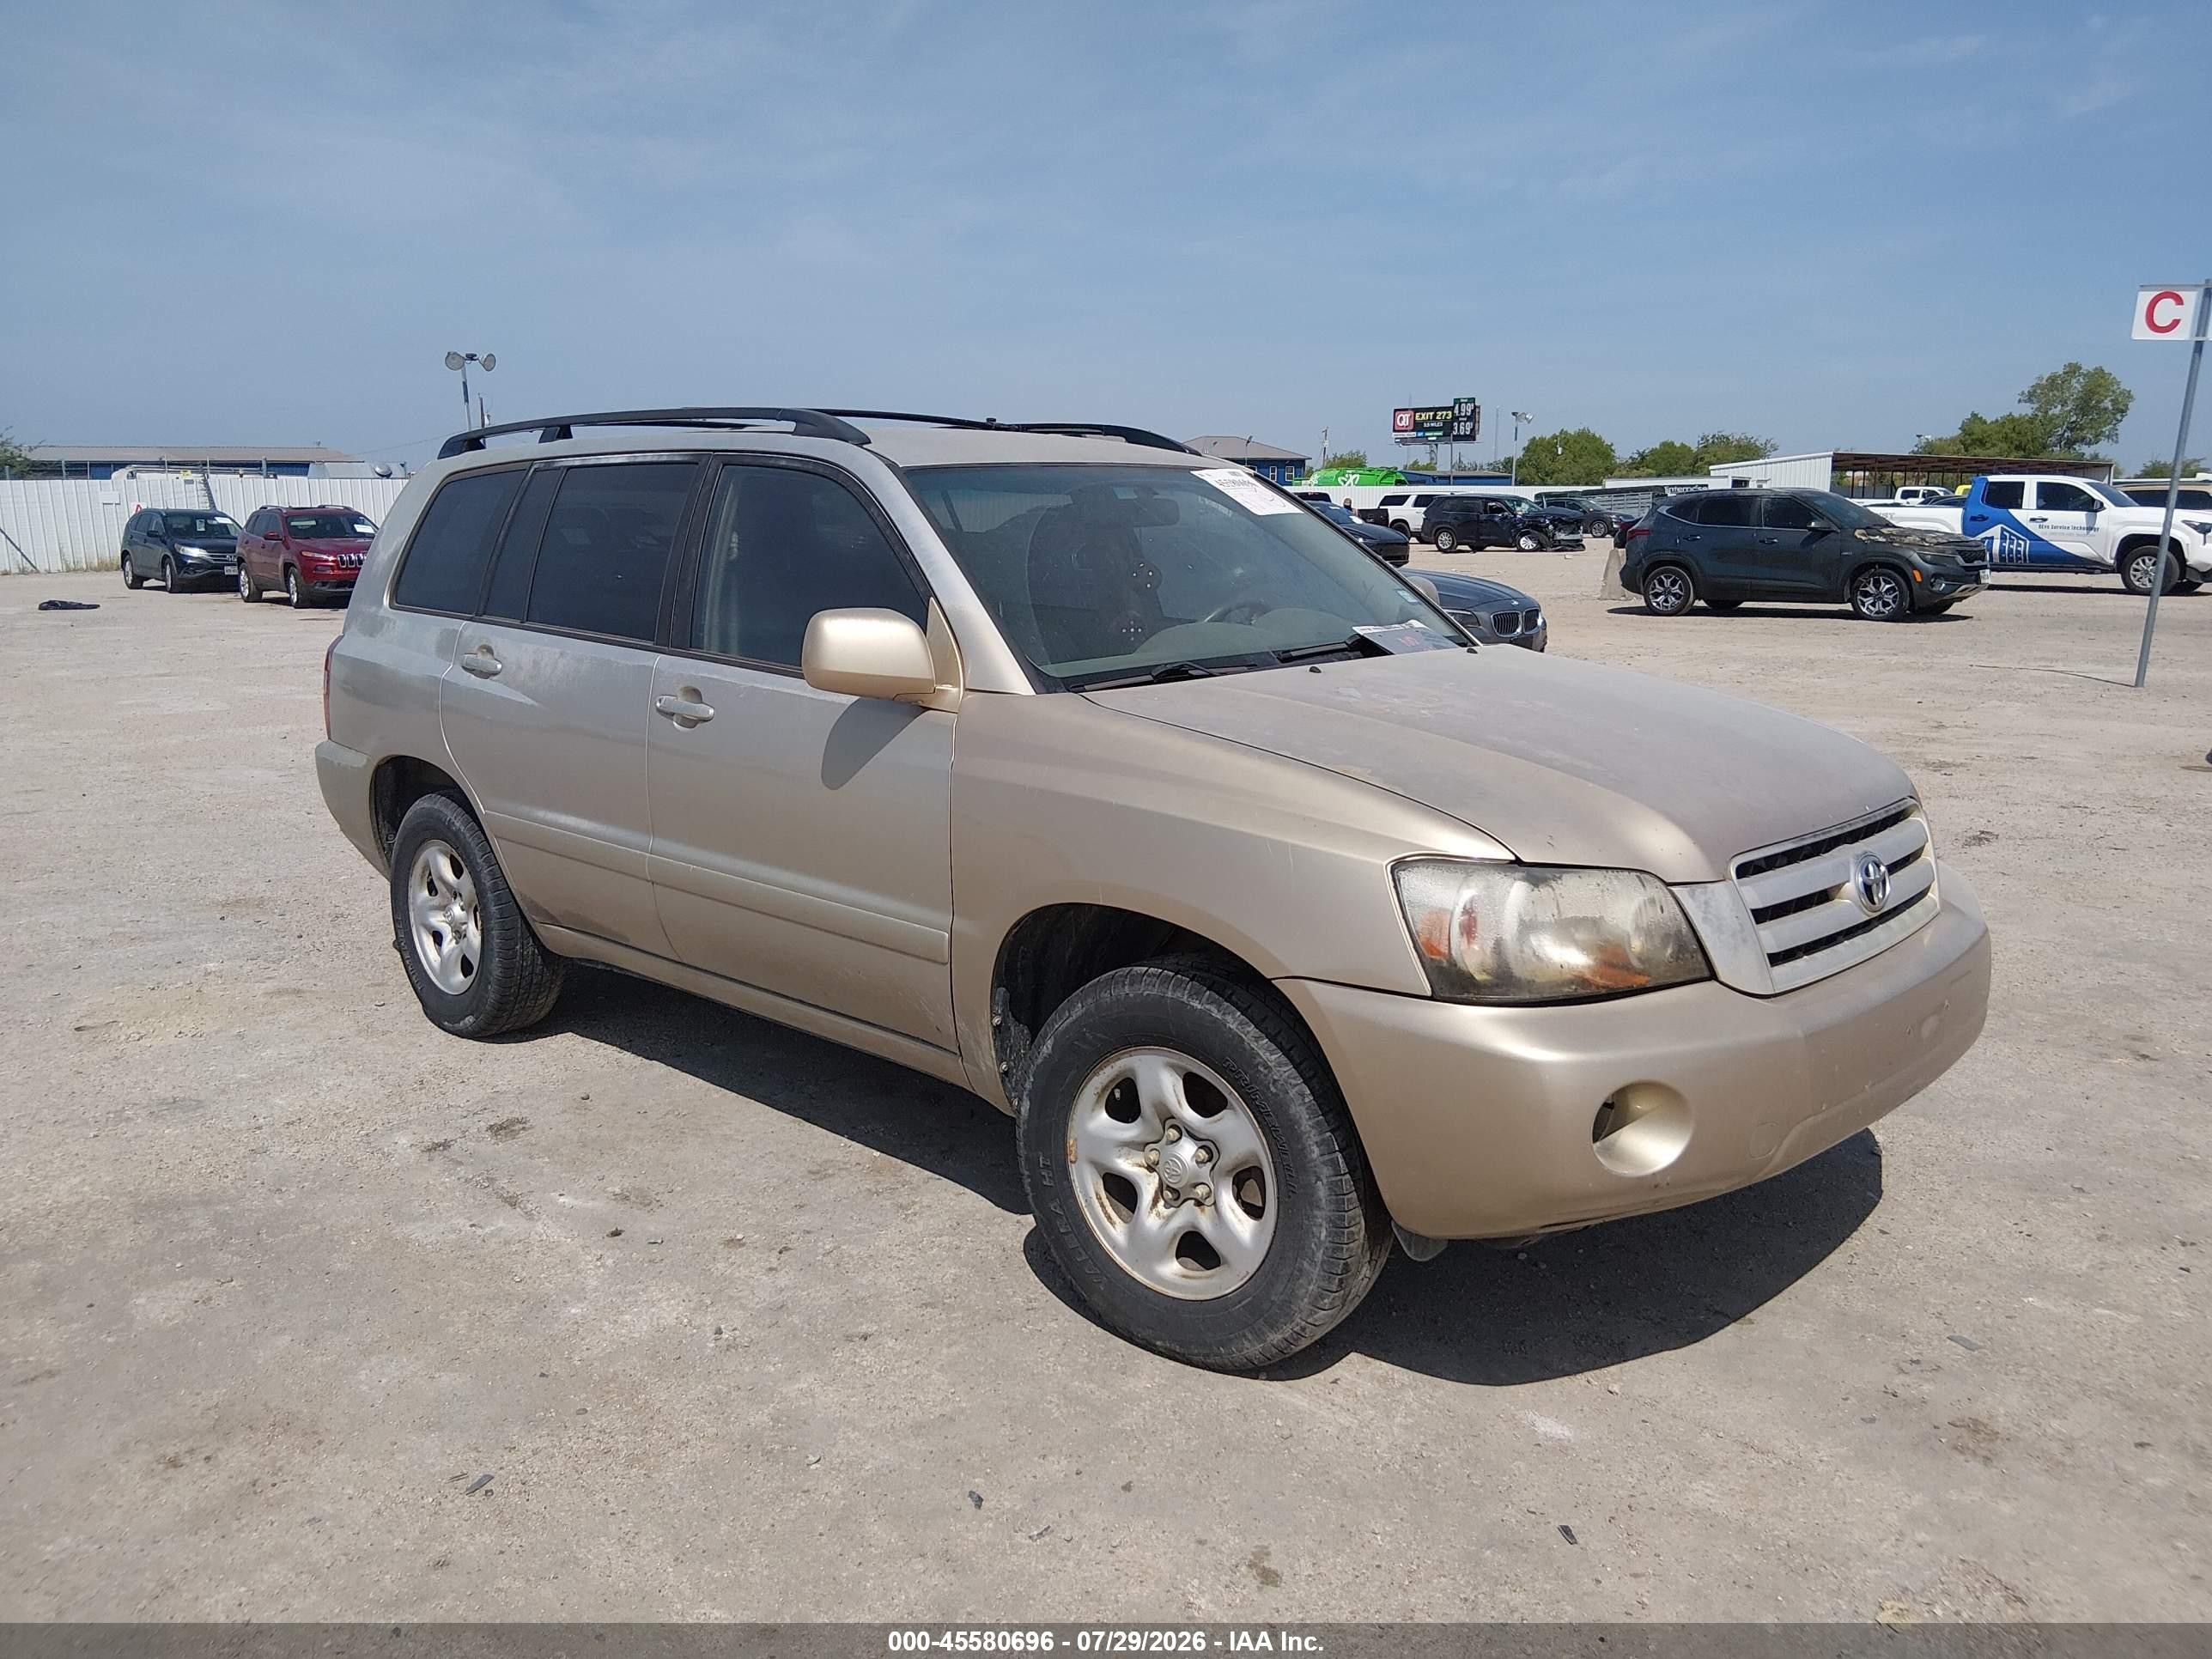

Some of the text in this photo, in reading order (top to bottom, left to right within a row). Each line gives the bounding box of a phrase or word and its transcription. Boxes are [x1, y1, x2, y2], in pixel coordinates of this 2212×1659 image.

[2145, 291, 2185, 334] C
[1397, 413, 1411, 427] QT
[1415, 410, 1452, 421] EXIT 273
